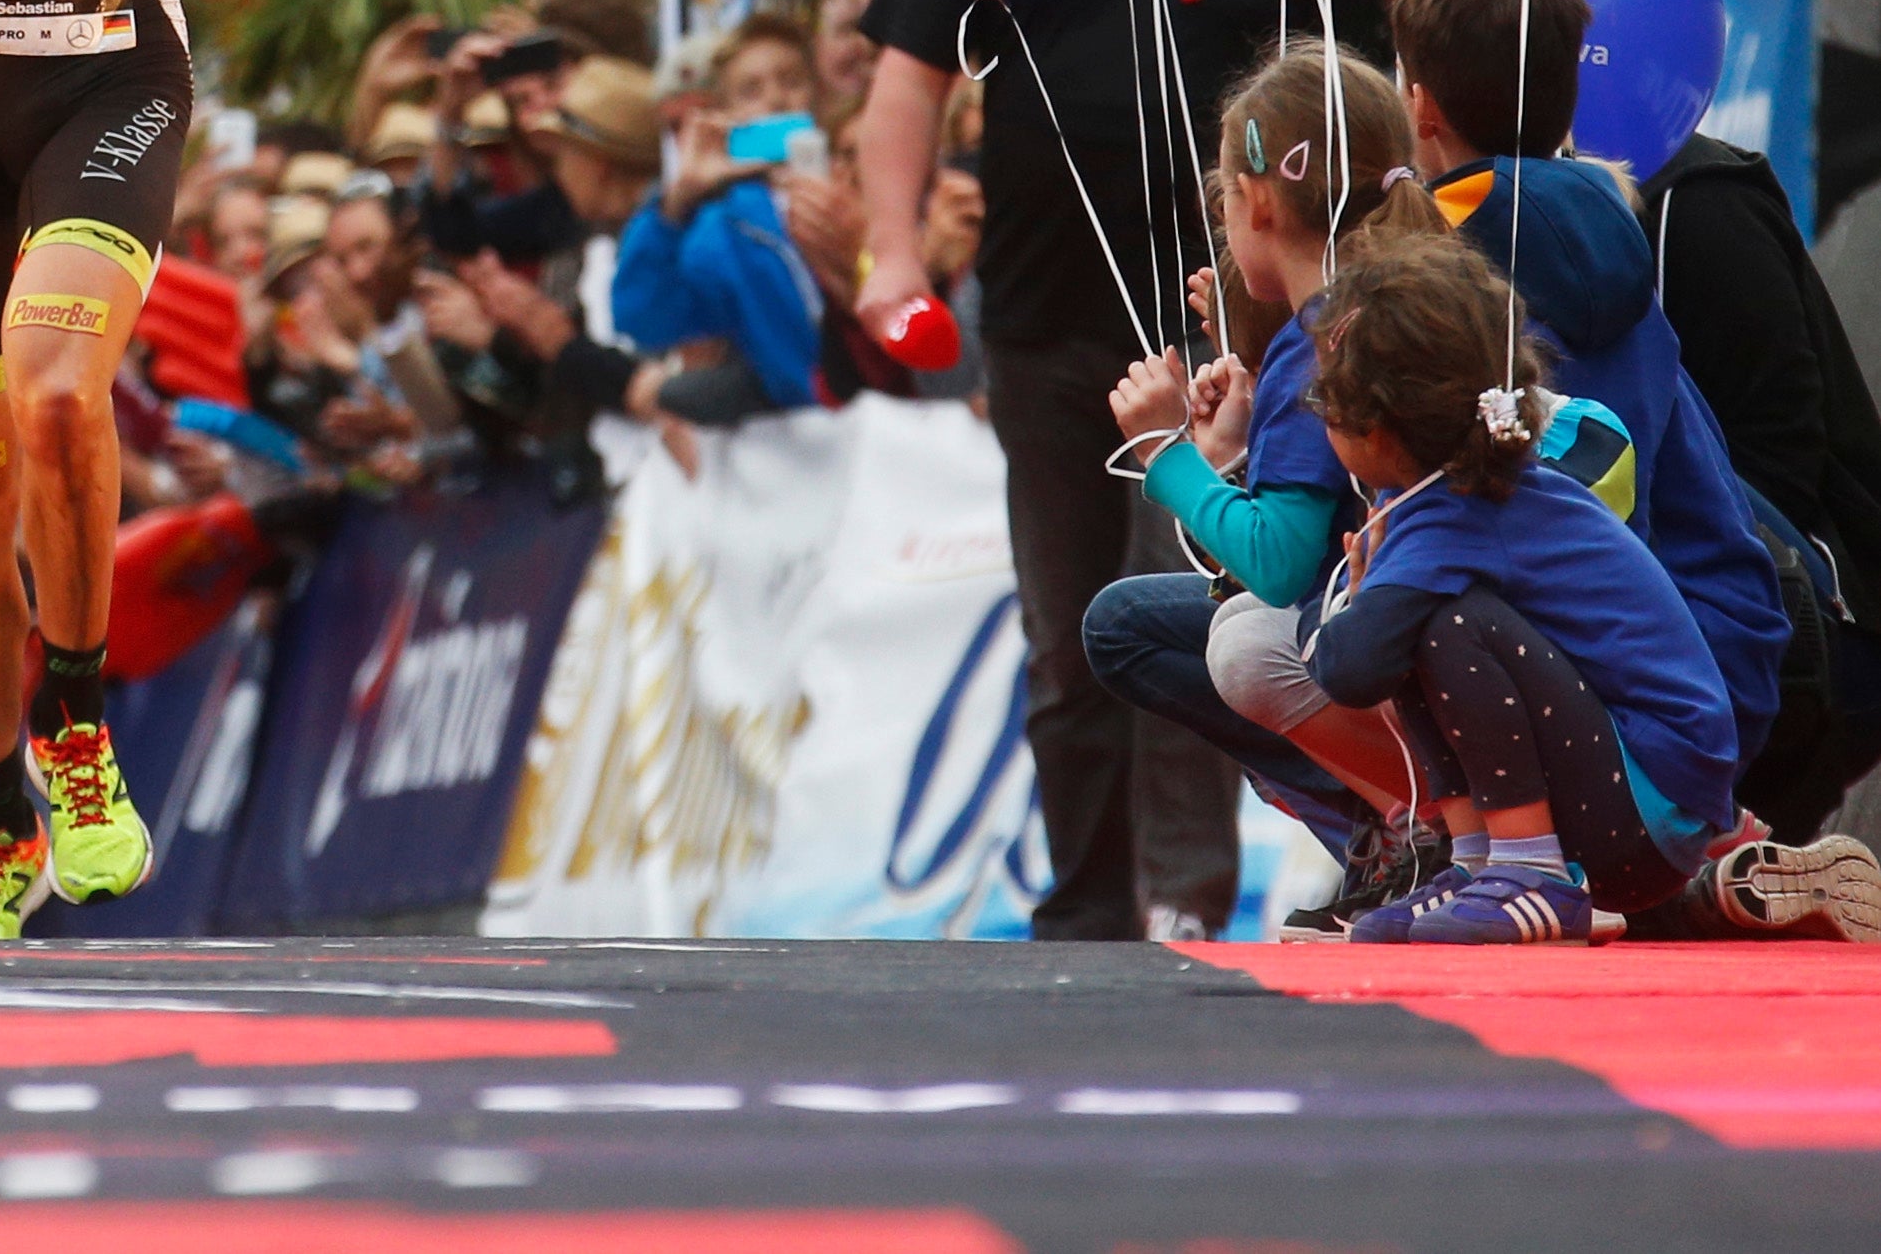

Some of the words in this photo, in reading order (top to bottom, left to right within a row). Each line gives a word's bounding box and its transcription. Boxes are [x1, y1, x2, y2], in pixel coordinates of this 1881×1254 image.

[40, 29, 52, 40] M
[80, 98, 177, 183] V-Klasse
[12, 298, 103, 329] PowerBar
